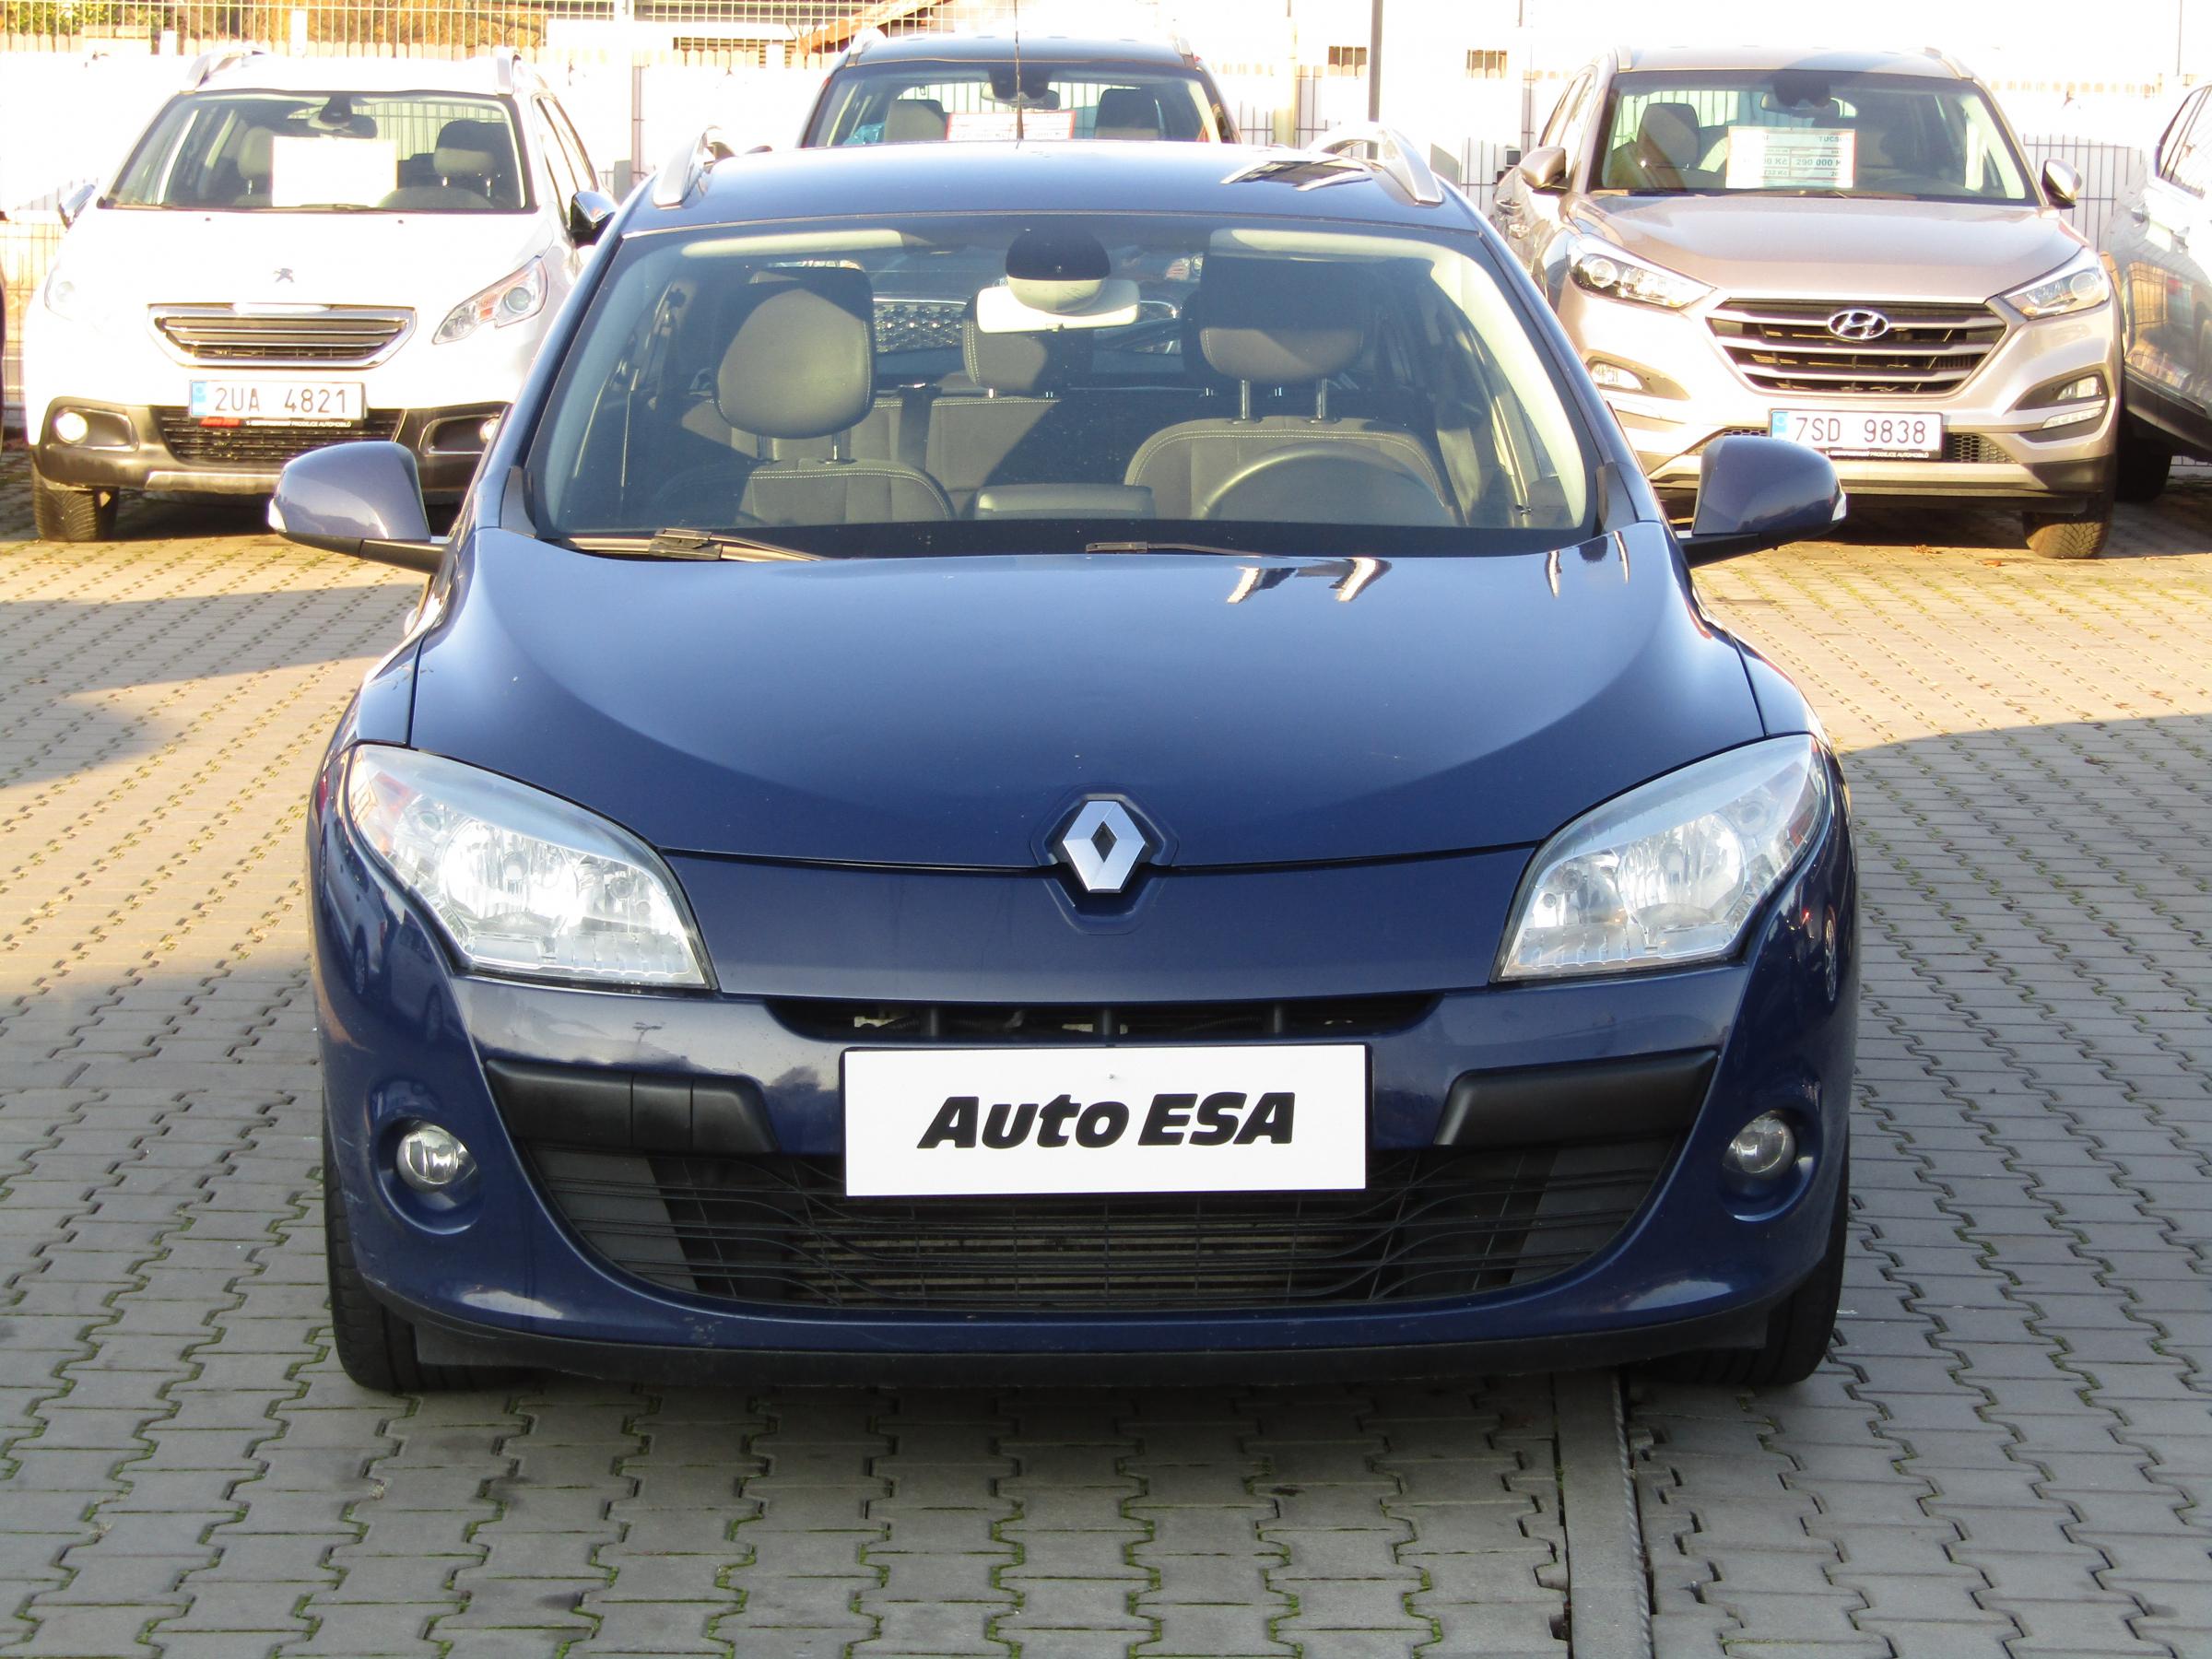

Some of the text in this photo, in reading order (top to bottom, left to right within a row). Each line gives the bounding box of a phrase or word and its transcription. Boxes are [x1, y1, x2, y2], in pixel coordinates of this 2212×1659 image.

[215, 387, 347, 413] 2UA 4821
[1795, 418, 1926, 443] 7SD 9838
[916, 1091, 1296, 1150] Auto ESA
